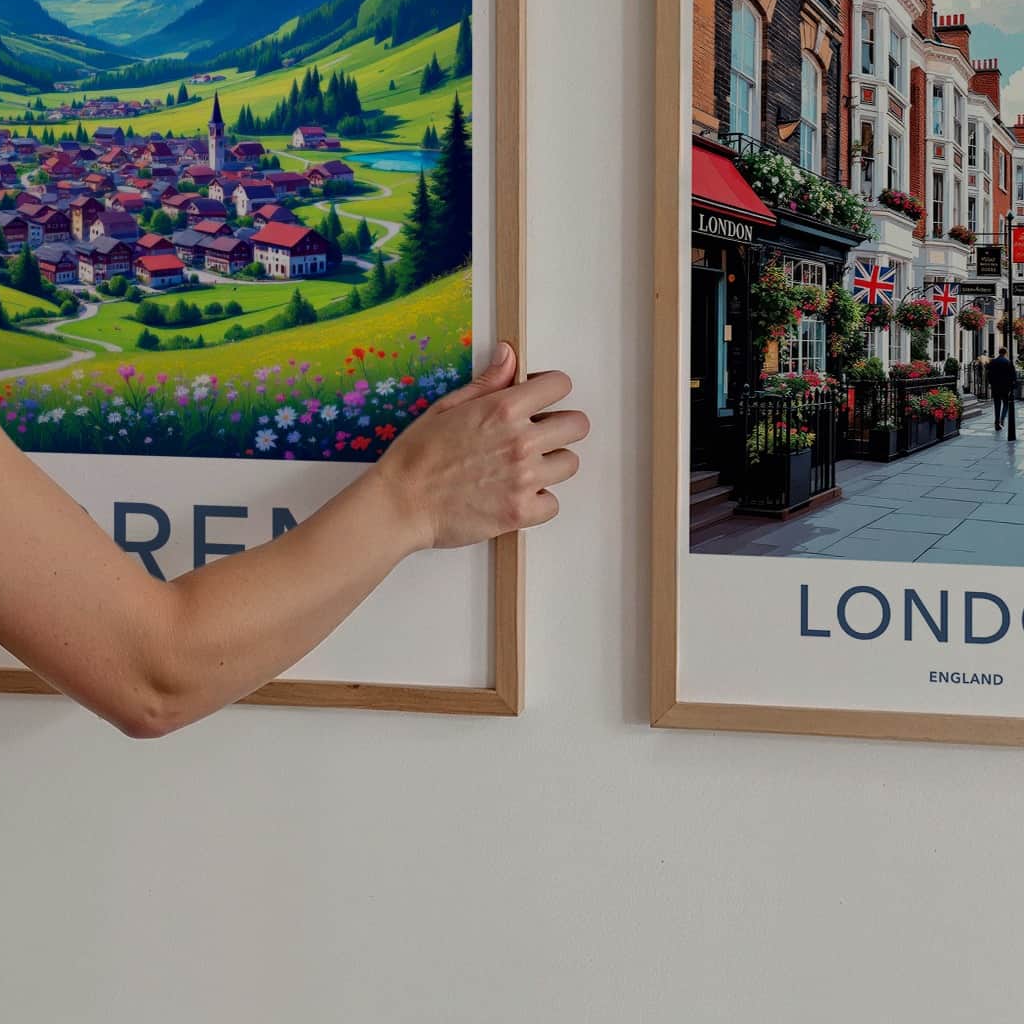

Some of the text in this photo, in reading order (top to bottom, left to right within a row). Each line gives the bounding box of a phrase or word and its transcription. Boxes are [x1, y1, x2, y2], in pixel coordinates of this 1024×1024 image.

[698, 213, 753, 242] LONDON
[800, 584, 1024, 645] LOND
[929, 671, 1004, 686] ENGLAND
